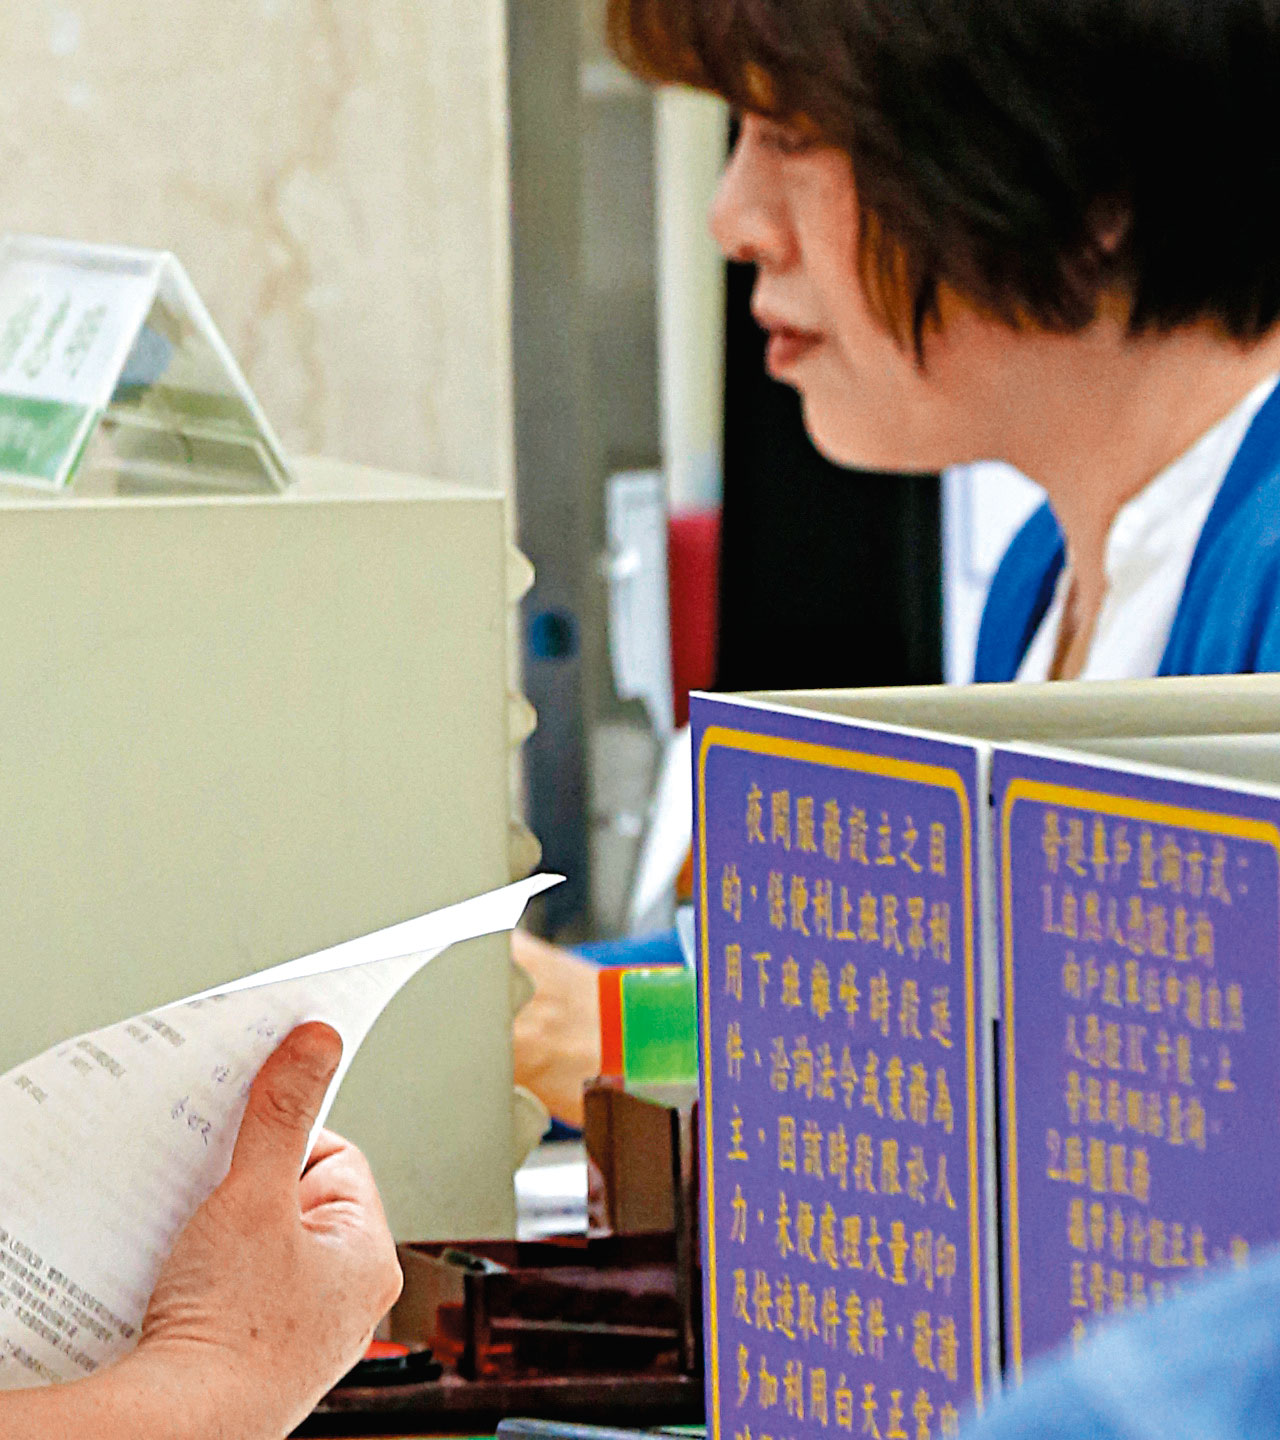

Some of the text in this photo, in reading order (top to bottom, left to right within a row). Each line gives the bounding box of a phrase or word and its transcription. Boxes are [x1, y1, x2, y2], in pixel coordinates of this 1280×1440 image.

[746, 782, 946, 876] 夜間服務設立之目
